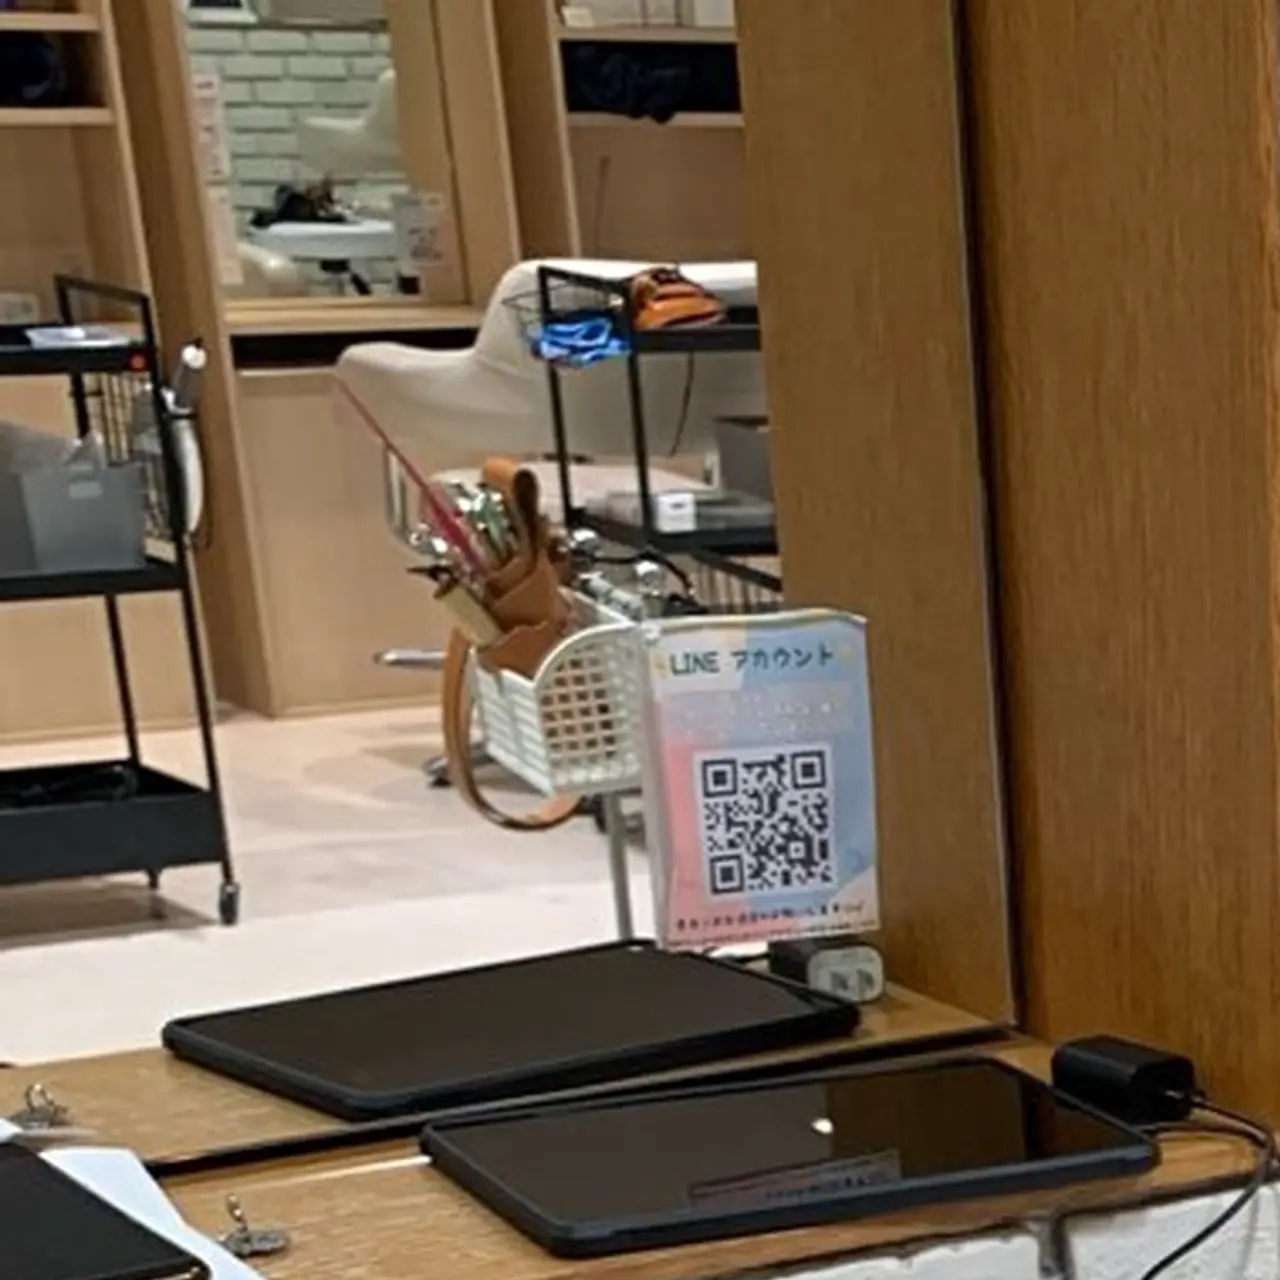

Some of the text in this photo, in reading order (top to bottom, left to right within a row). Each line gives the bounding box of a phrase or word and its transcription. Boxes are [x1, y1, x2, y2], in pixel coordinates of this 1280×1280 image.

[669, 645, 835, 675] LINE アカウント
